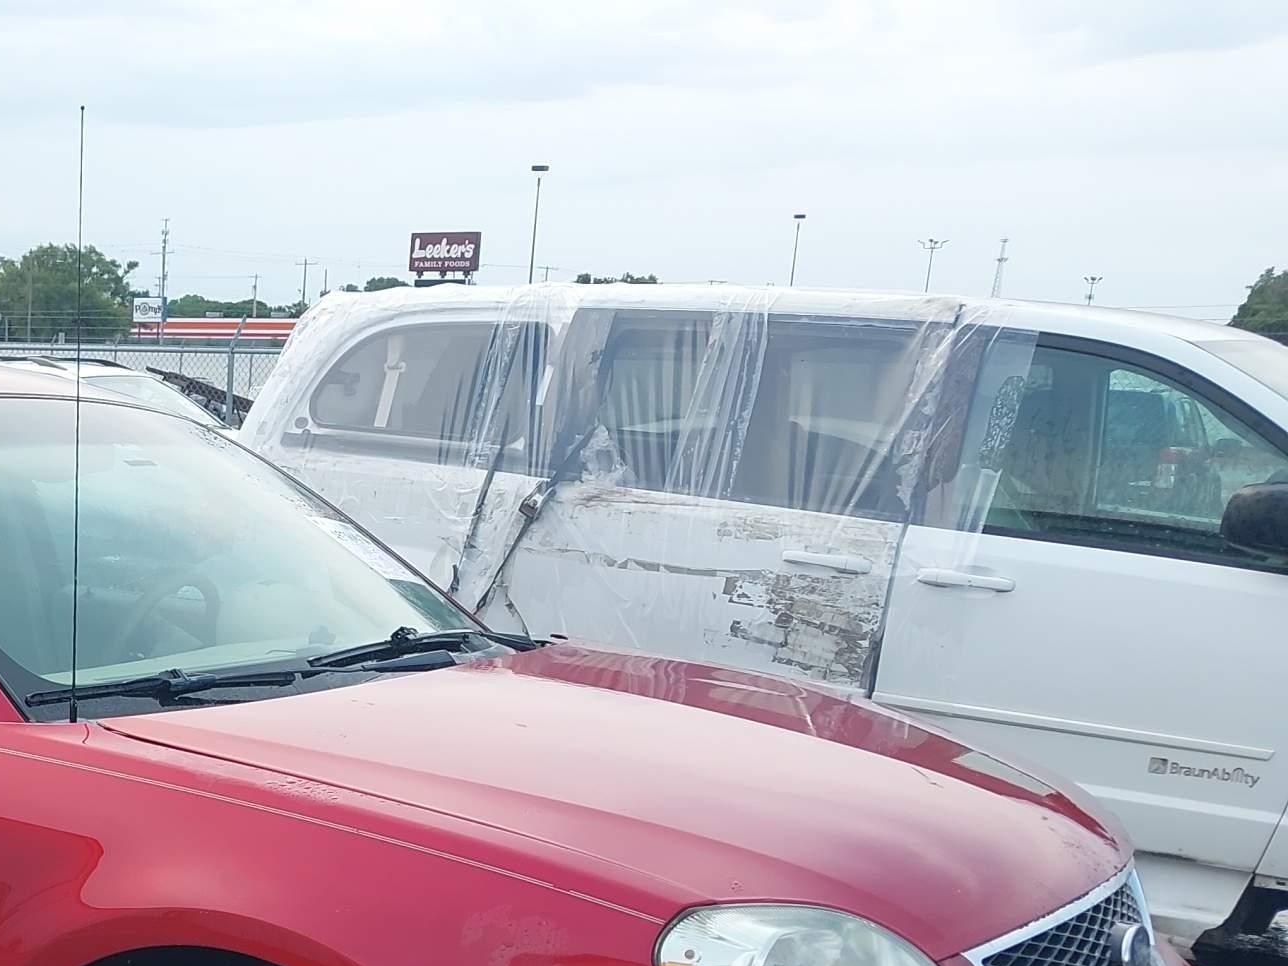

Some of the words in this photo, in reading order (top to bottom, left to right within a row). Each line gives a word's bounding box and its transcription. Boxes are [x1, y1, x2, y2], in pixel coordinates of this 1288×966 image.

[412, 237, 475, 259] Leeker's
[414, 260, 442, 268] FAMILY
[444, 260, 471, 268] FOODS
